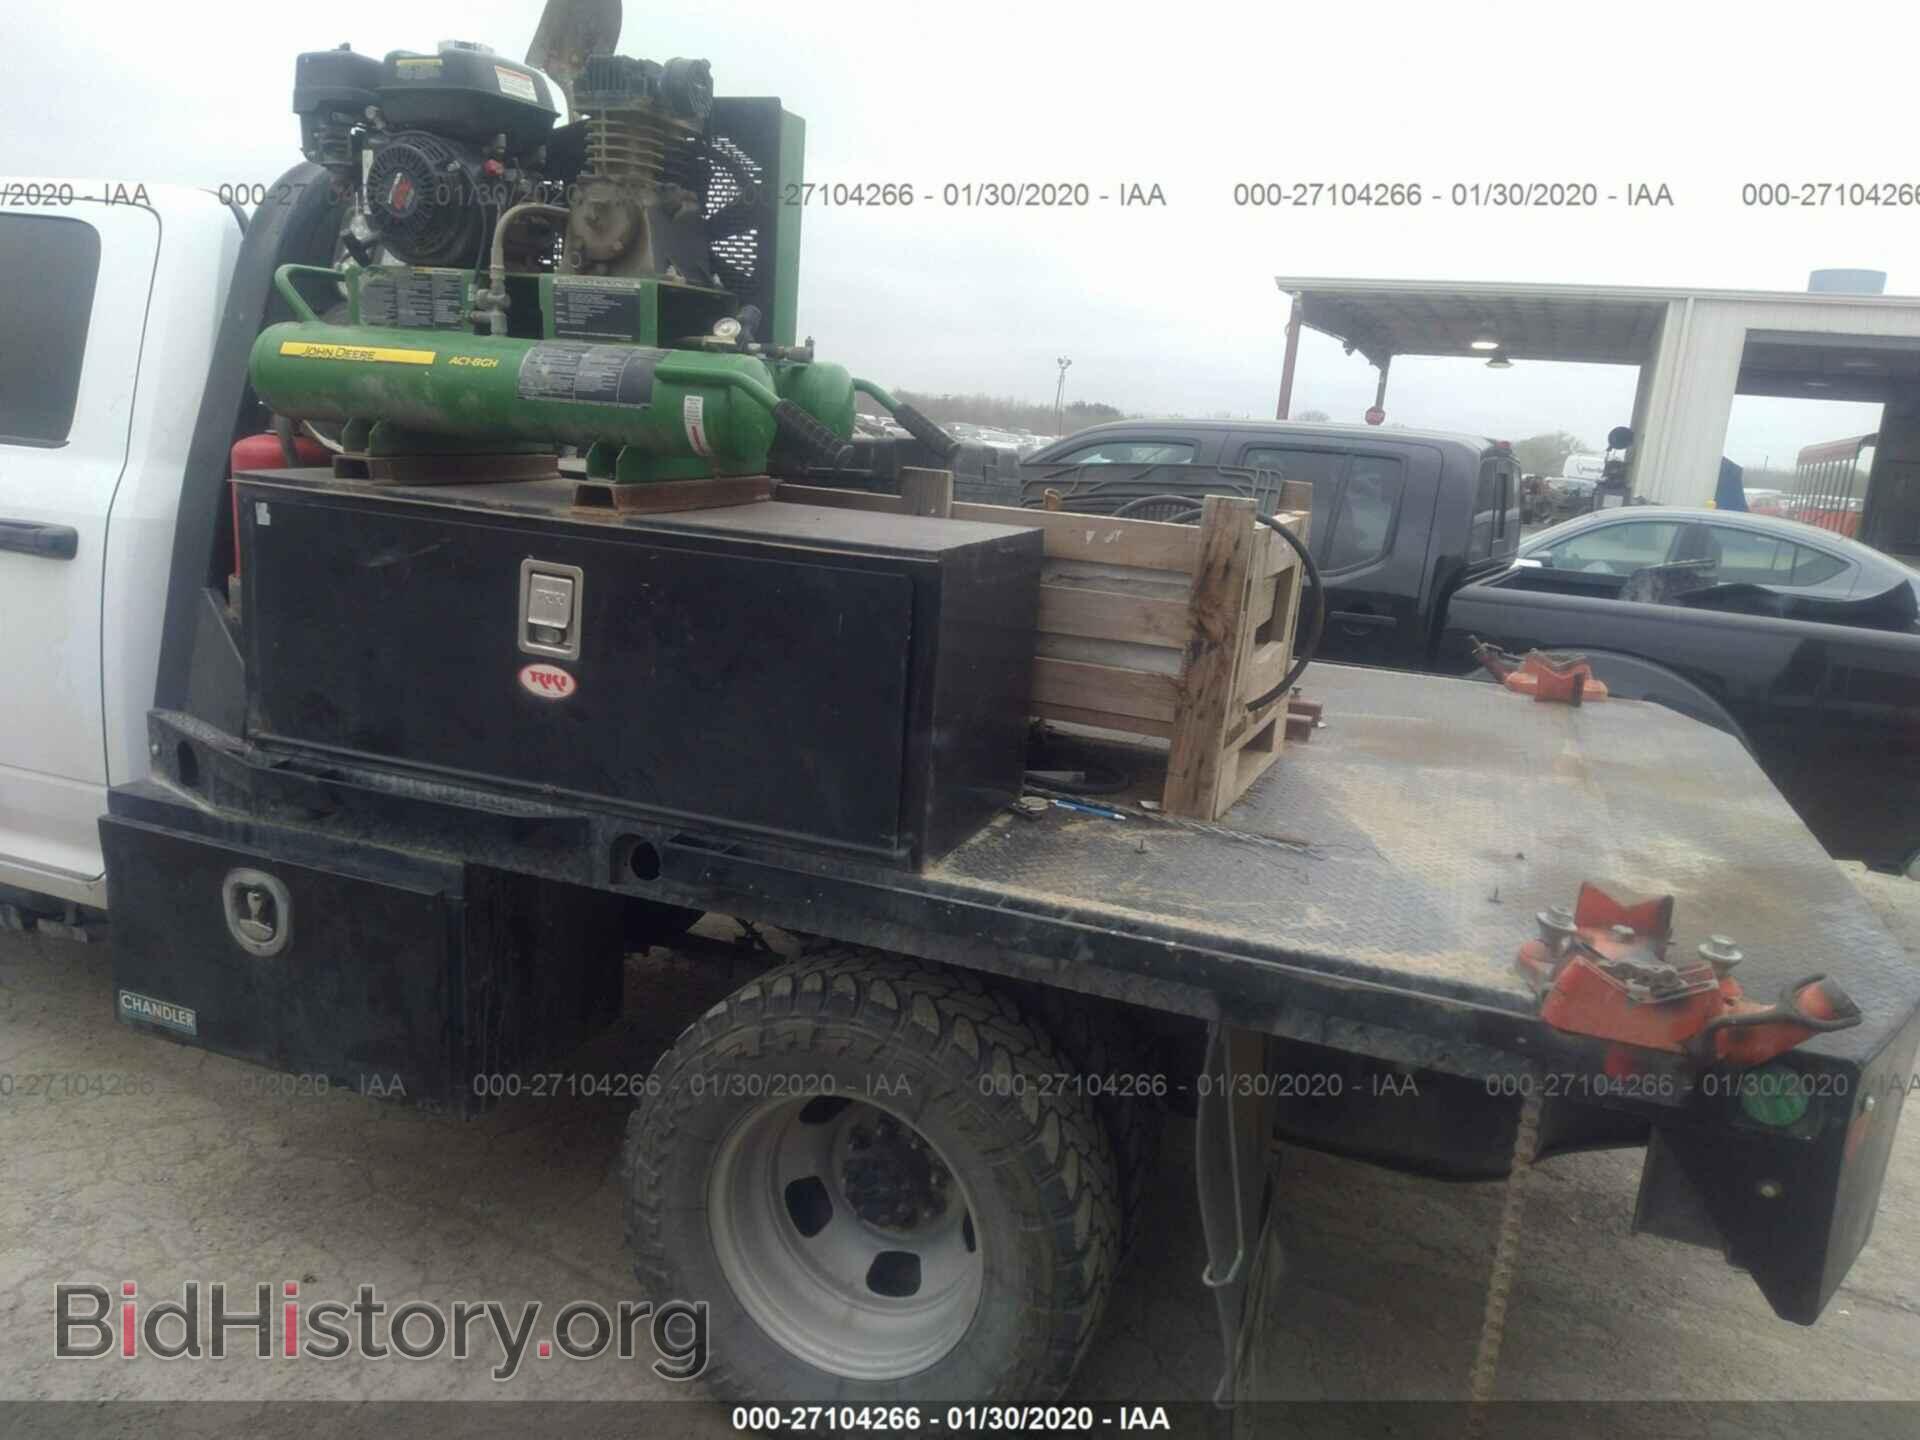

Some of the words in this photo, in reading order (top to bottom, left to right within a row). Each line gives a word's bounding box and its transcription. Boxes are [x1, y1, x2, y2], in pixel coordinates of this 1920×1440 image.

[301, 344, 333, 359] JOHN
[335, 347, 377, 362] DEERE
[121, 994, 194, 1027] CHANDLER
